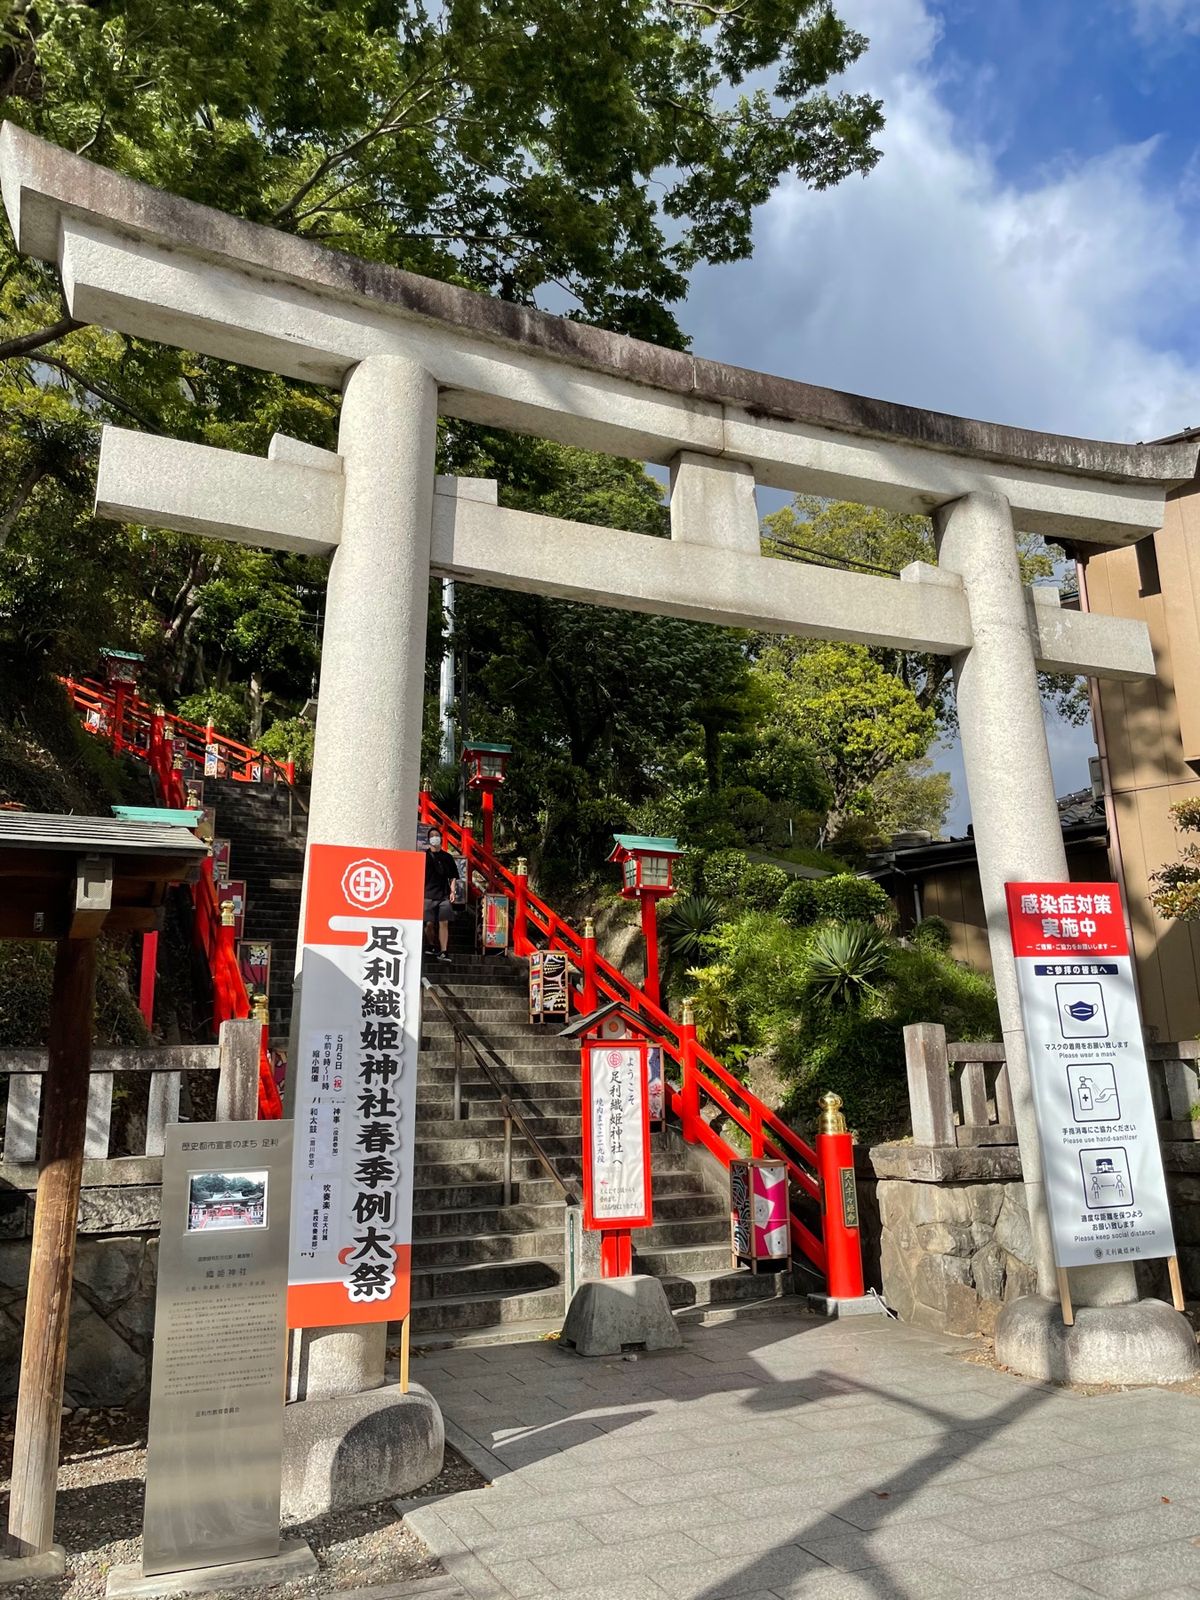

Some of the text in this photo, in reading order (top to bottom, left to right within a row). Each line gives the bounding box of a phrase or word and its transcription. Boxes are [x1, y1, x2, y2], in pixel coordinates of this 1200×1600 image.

[1021, 893, 1113, 915] 感染症対策
[1041, 917, 1097, 938] 実施中
[1046, 965, 1108, 975] ご参拝の皆様へ
[1044, 1041, 1129, 1051] マスクの着用をお願い致します
[311, 1049, 320, 1082] 縮小開催
[626, 1057, 635, 1106] ようこそ
[349, 925, 404, 1297] 足利織姫神社春季例大祭
[609, 1070, 624, 1165] 足利織姫神社へ
[1062, 1124, 1137, 1136] 手指消毒にご協力ください
[181, 1138, 279, 1151] 歴史都市宣言のまち 足利
[1062, 1137, 1083, 1145] Please
[1095, 1134, 1138, 1142] hand-sanitizer
[1081, 1210, 1143, 1223] 適度な距離を保つよう
[1092, 1220, 1135, 1231] お願い致します
[1074, 1234, 1095, 1242] Please
[1111, 1231, 1130, 1239] social
[1130, 1229, 1156, 1237] distance
